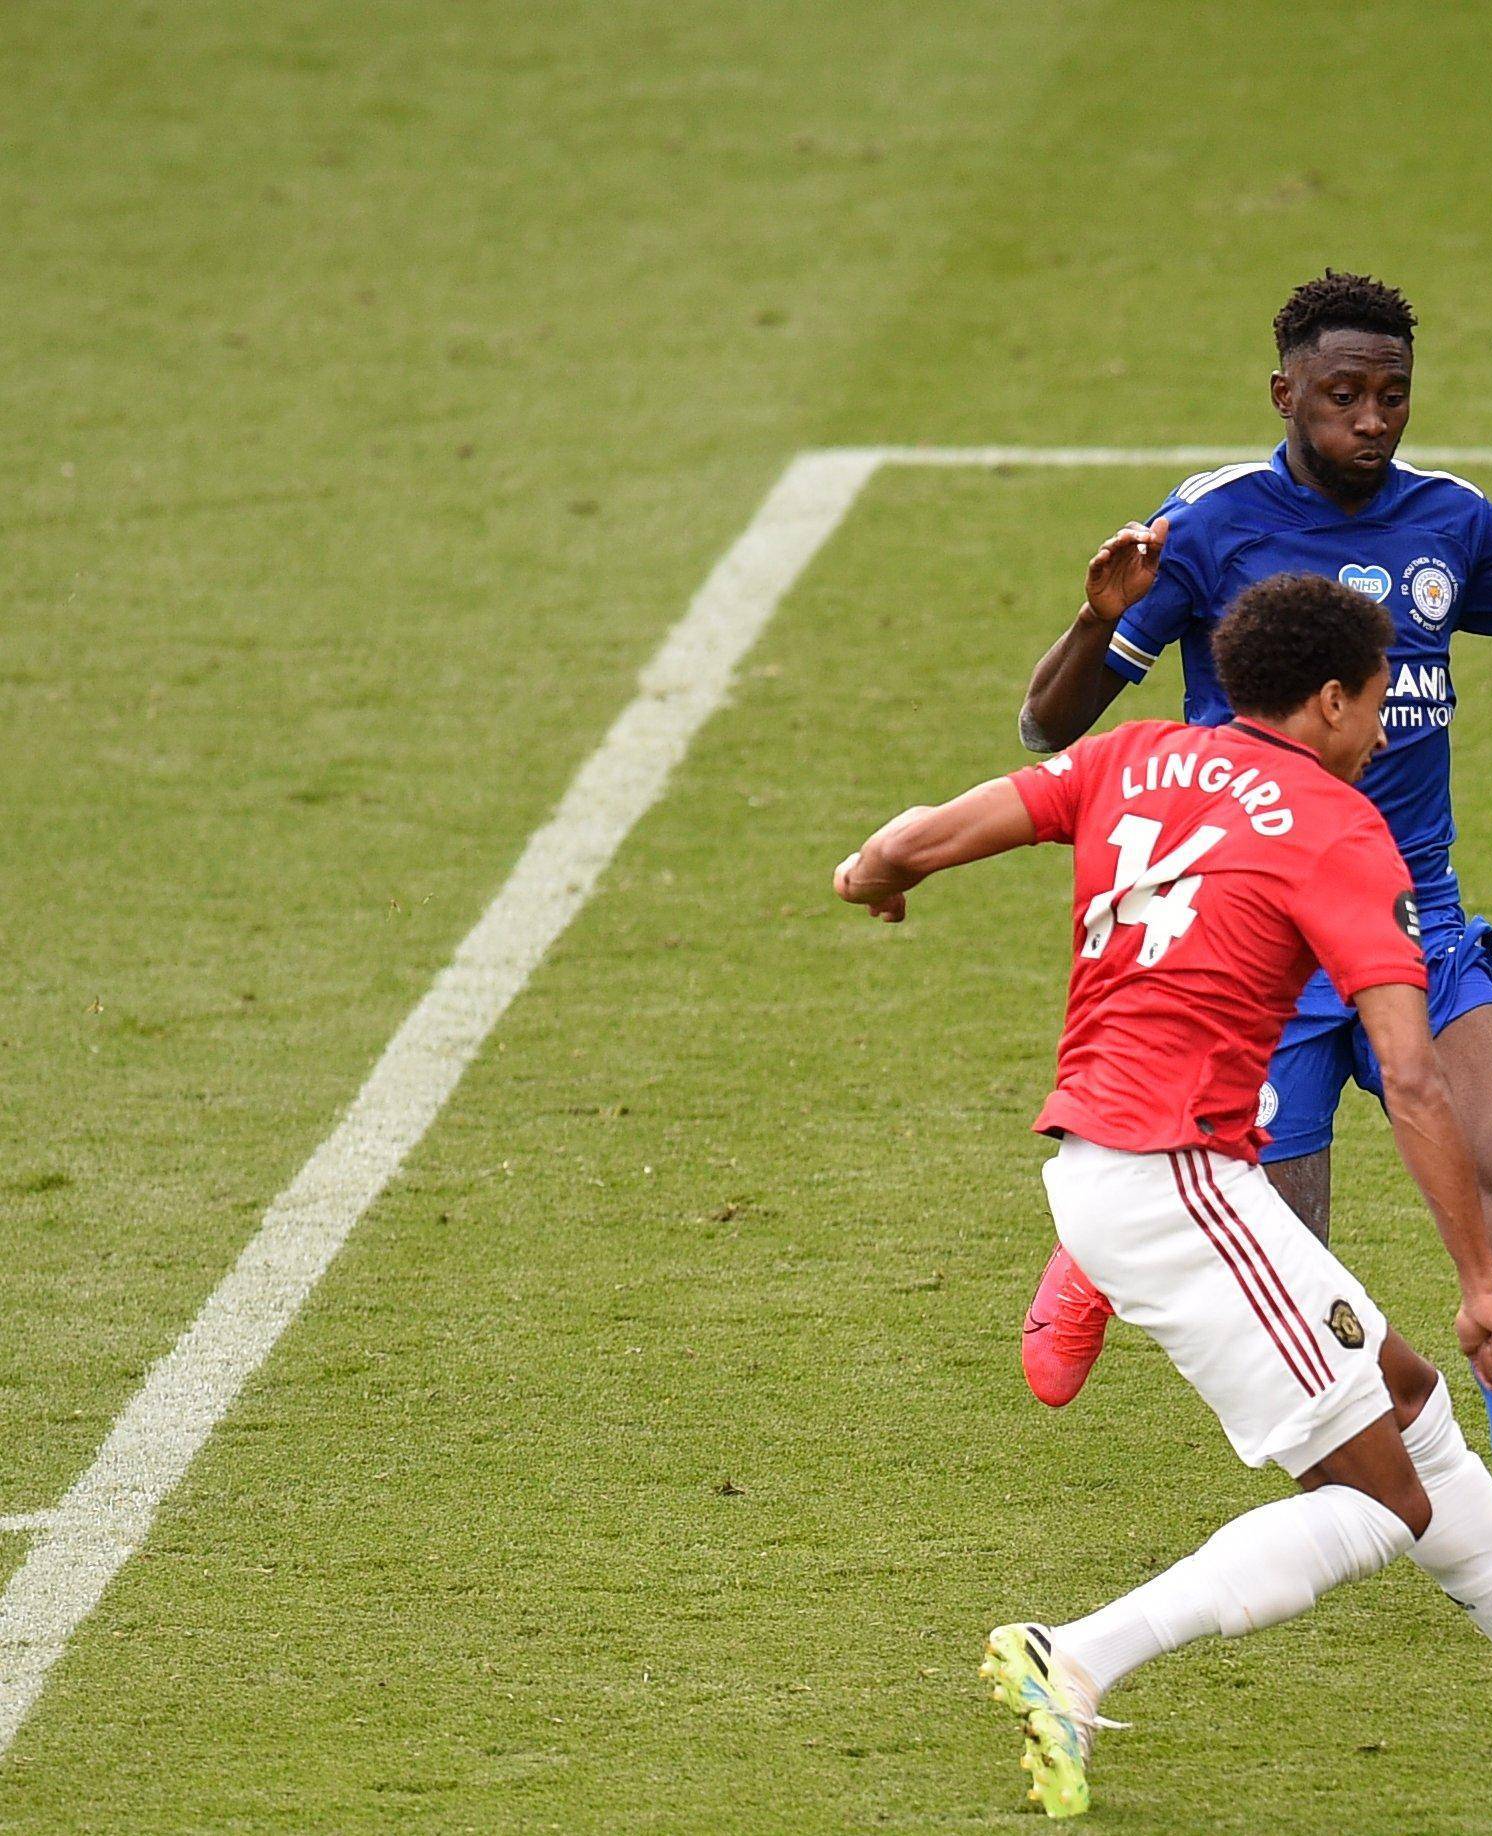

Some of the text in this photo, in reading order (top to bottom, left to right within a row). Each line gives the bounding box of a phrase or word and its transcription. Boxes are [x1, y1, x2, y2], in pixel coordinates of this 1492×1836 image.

[1350, 579, 1380, 592] NHS
[1385, 663, 1447, 701] AND
[1122, 753, 1293, 836] LINGARD
[1080, 813, 1227, 967] 14
